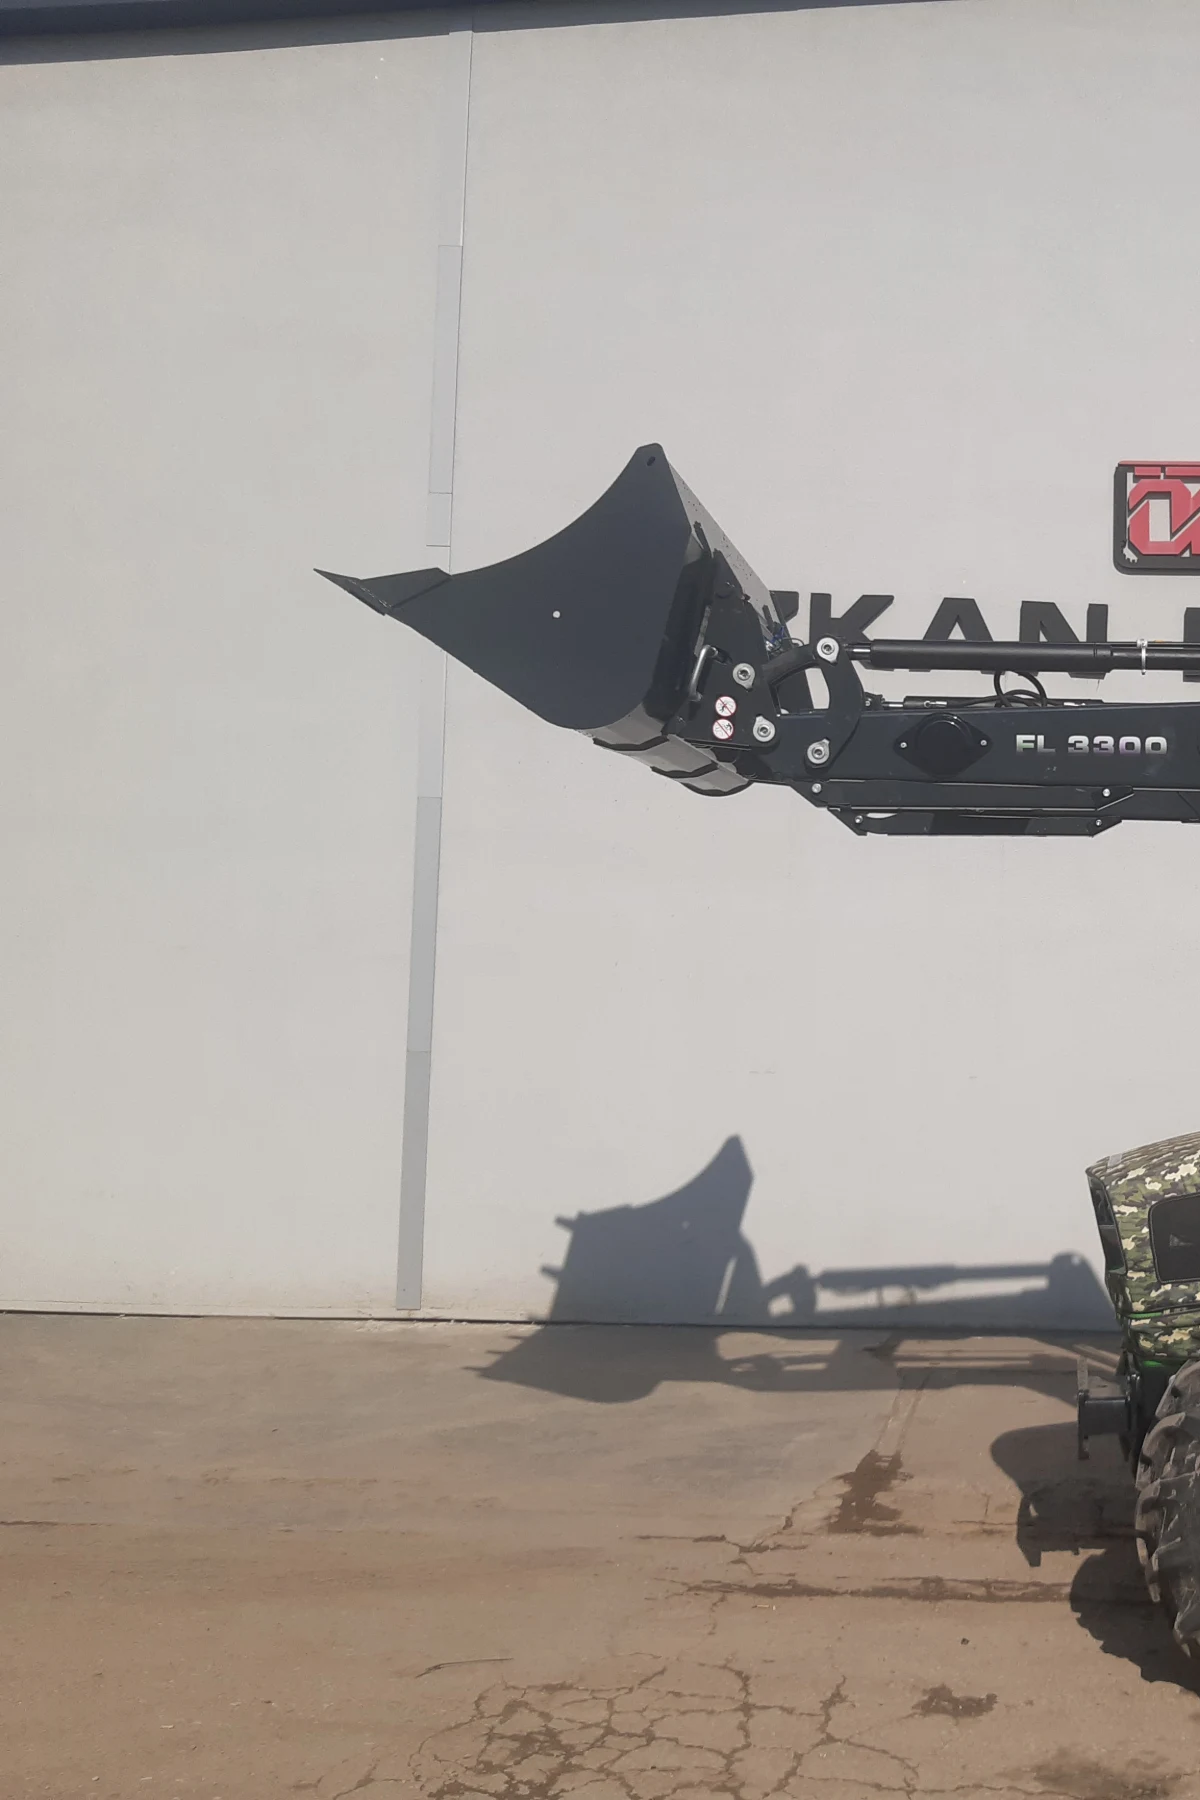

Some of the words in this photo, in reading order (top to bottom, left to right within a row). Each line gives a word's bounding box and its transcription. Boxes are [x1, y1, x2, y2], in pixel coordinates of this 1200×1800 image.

[768, 590, 1109, 679] KAN
[1016, 734, 1056, 754] FL
[1067, 735, 1168, 756] 3300
